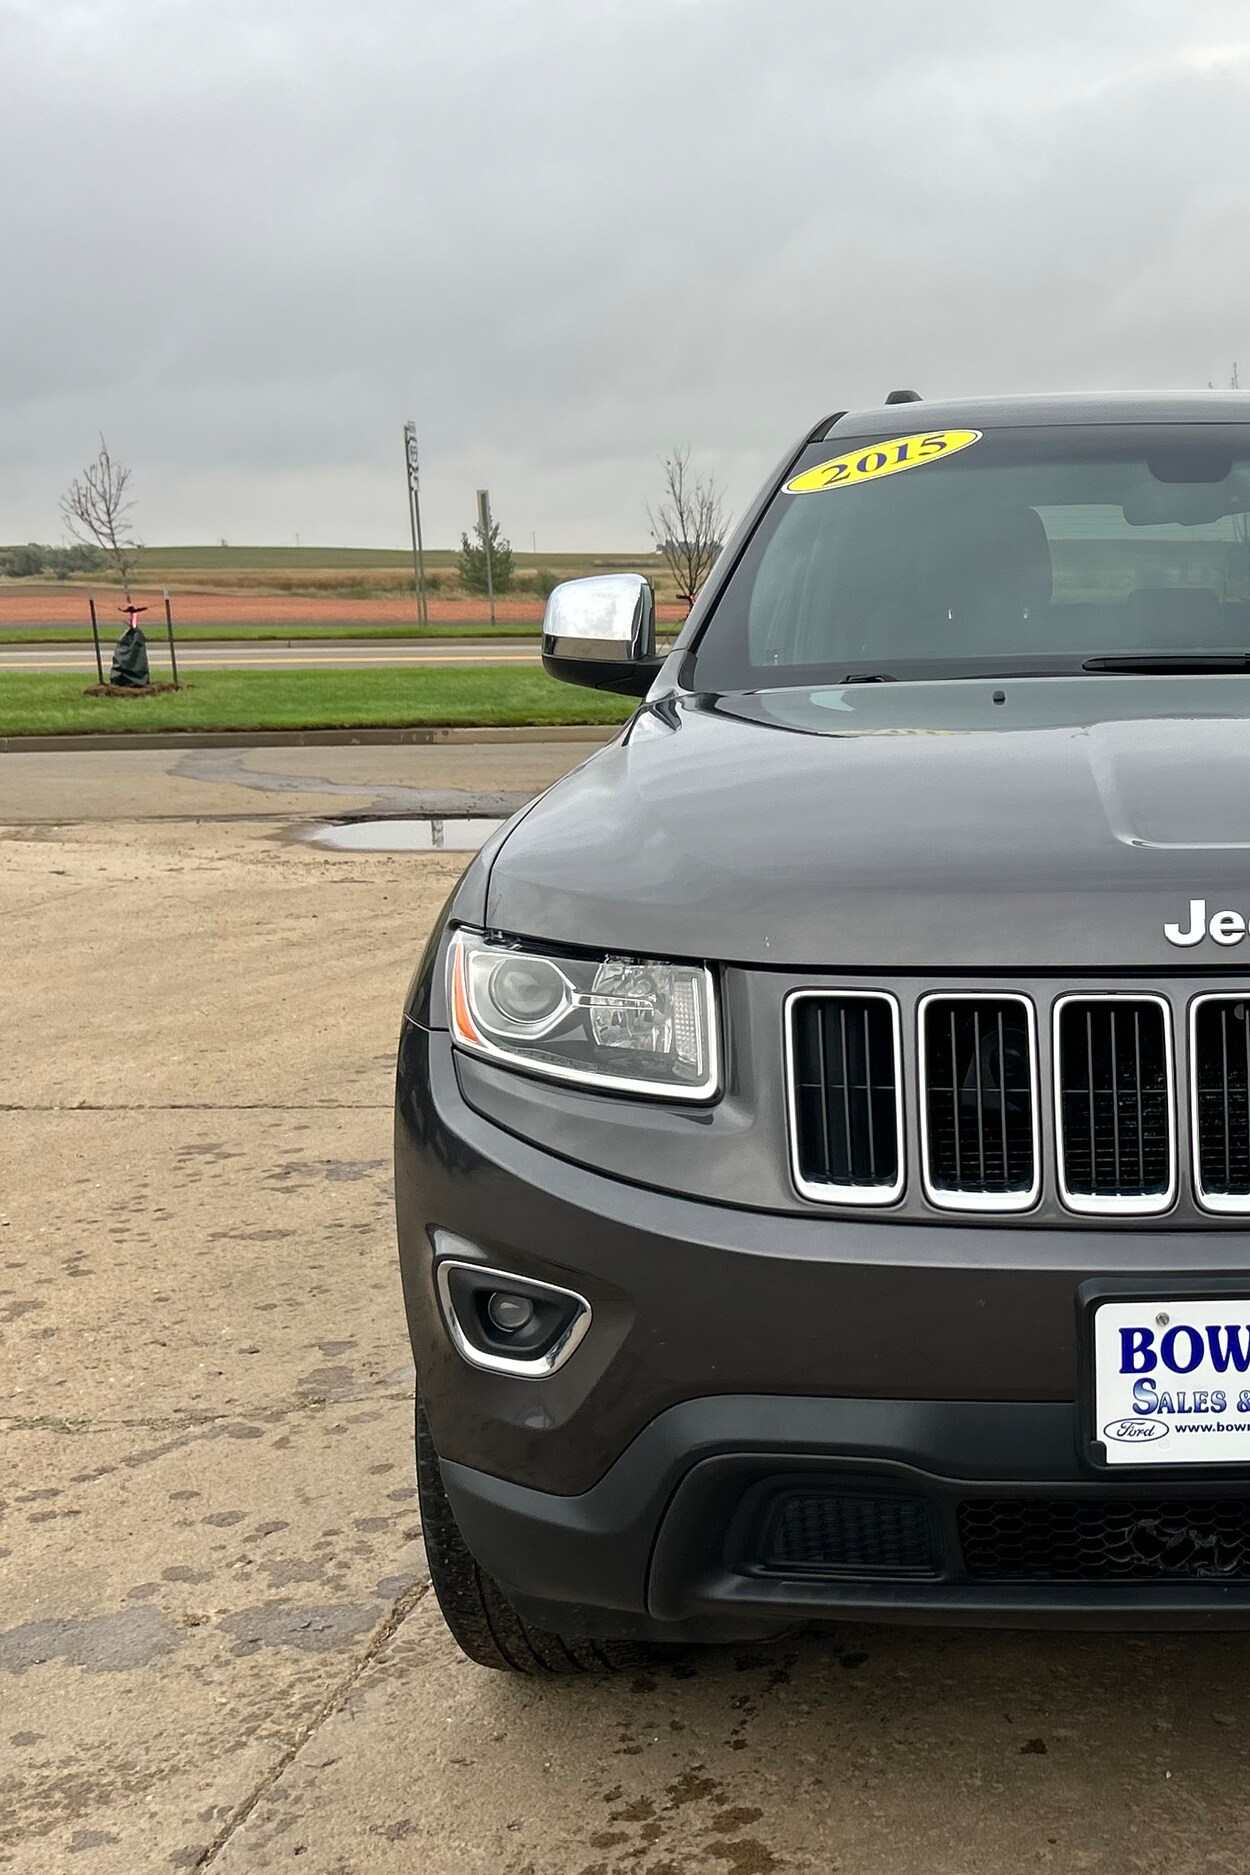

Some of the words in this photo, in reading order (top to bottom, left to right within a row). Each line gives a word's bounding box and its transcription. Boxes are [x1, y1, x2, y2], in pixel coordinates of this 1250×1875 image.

[821, 434, 947, 486] 2015
[1132, 1377, 1227, 1415] SALES
[1116, 1421, 1155, 1437] Ford
